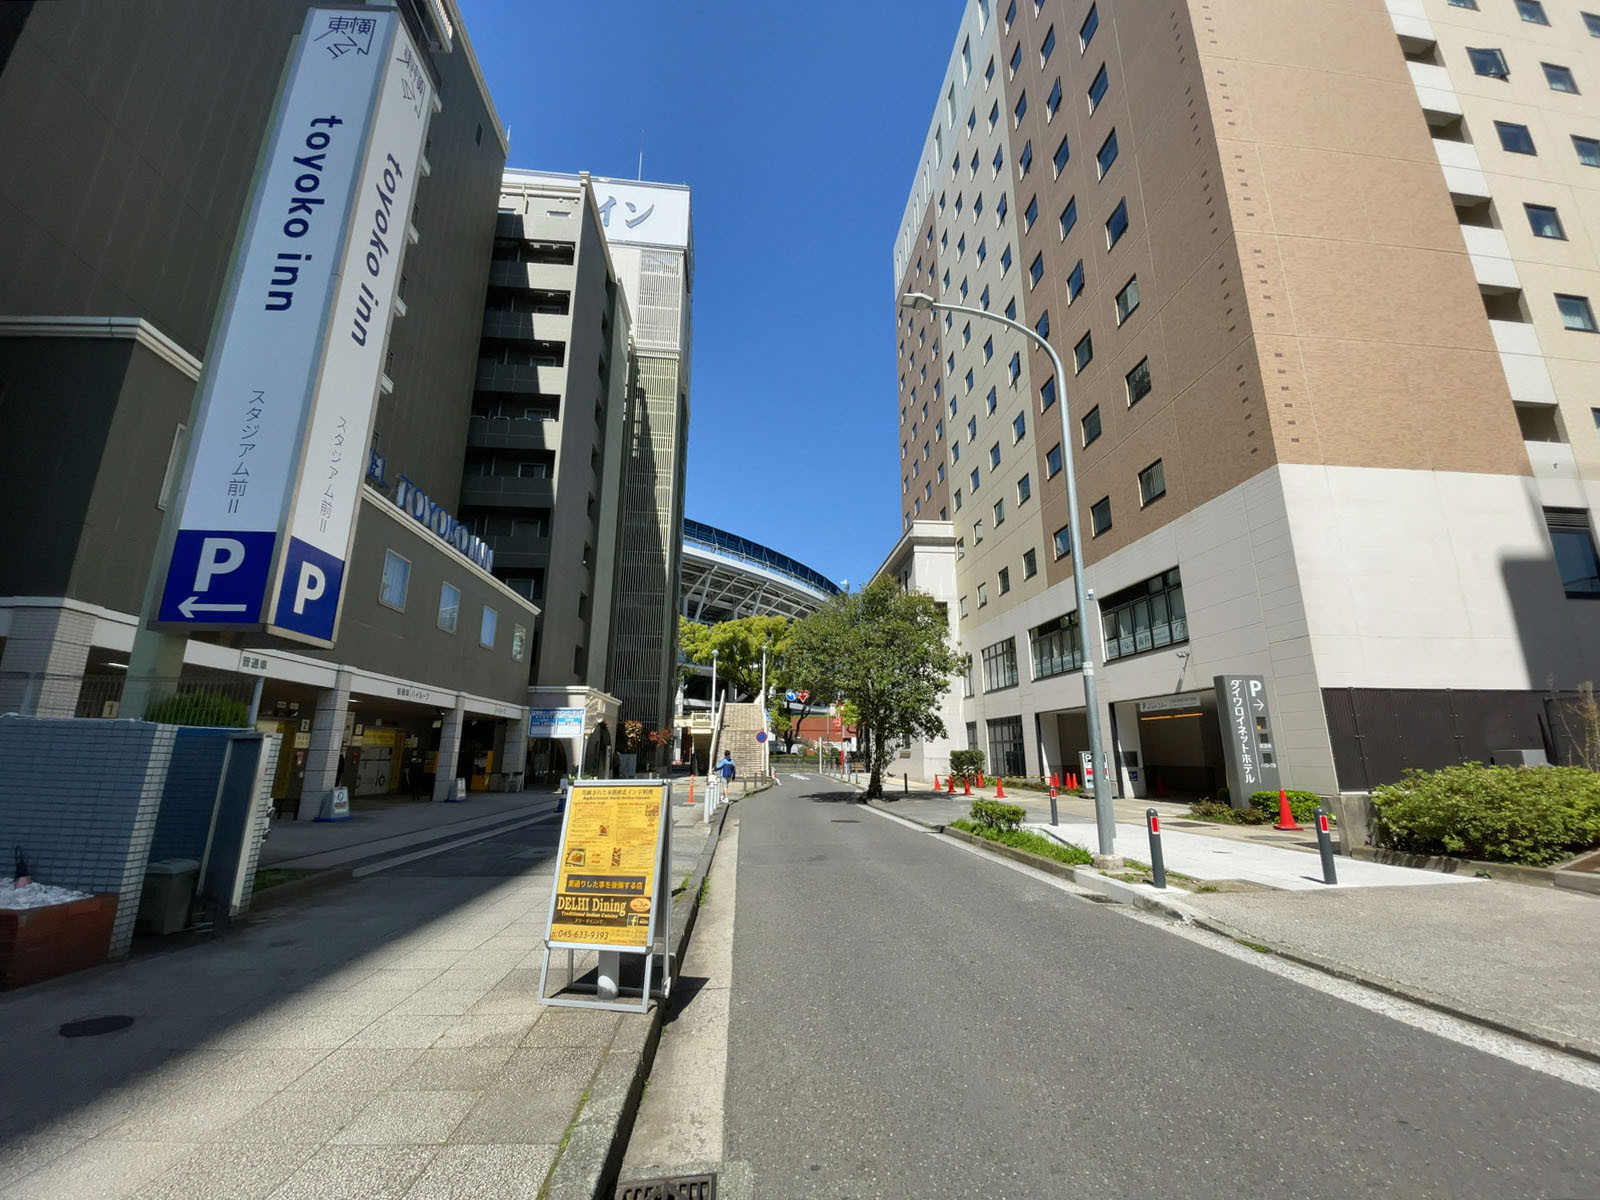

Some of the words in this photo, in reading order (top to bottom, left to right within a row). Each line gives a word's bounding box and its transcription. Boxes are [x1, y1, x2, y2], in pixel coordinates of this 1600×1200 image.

[283, 115, 343, 239] toyoko
[366, 153, 403, 277] toyoko
[264, 253, 312, 311] inn
[350, 282, 379, 347] inn
[193, 537, 246, 592] P
[293, 561, 326, 615] P
[242, 656, 268, 670] 普通車
[1249, 680, 1262, 697] P
[1230, 680, 1256, 784] ダイワロイネットホテル
[557, 896, 589, 911] DELHI
[592, 898, 627, 917] Dining
[557, 929, 609, 941] 045-633-9393
